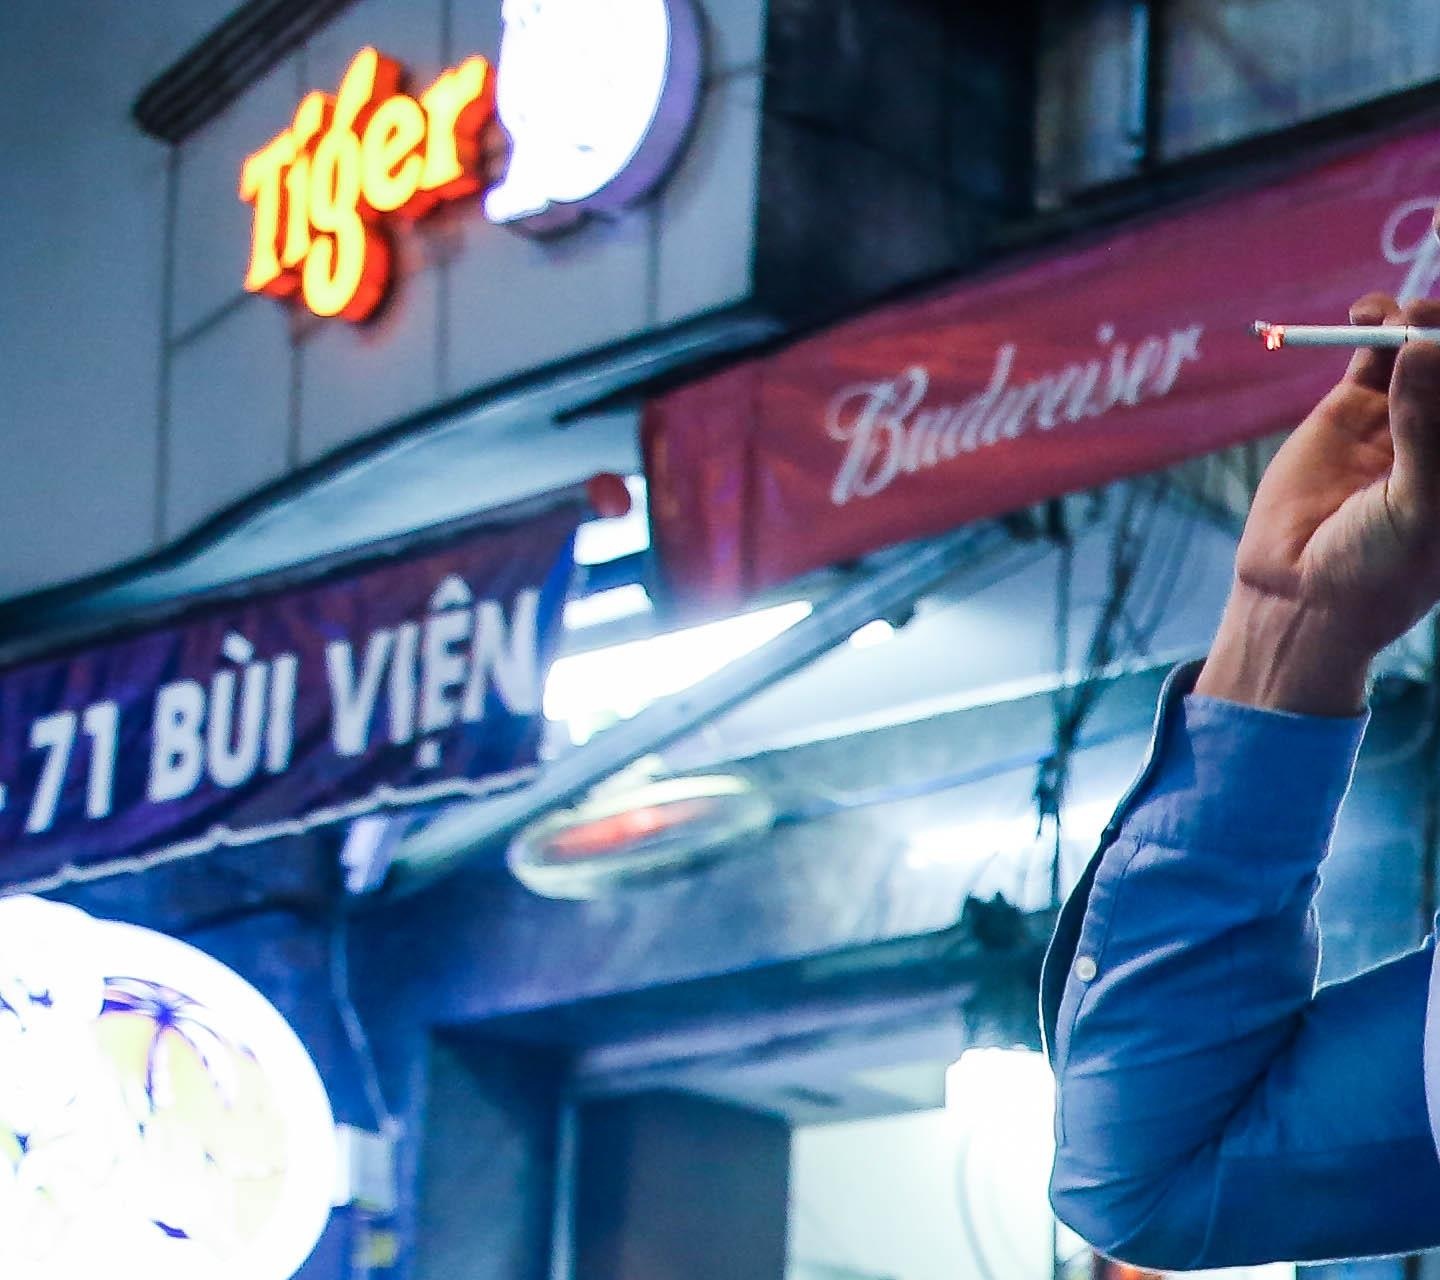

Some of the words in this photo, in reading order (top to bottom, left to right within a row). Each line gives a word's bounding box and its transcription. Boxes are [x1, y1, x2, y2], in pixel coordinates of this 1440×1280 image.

[240, 45, 489, 318] Tiger
[826, 323, 1204, 504] Budweiser
[25, 699, 120, 833] 71
[148, 631, 298, 803] BÙI
[324, 574, 542, 769] VIỆN
